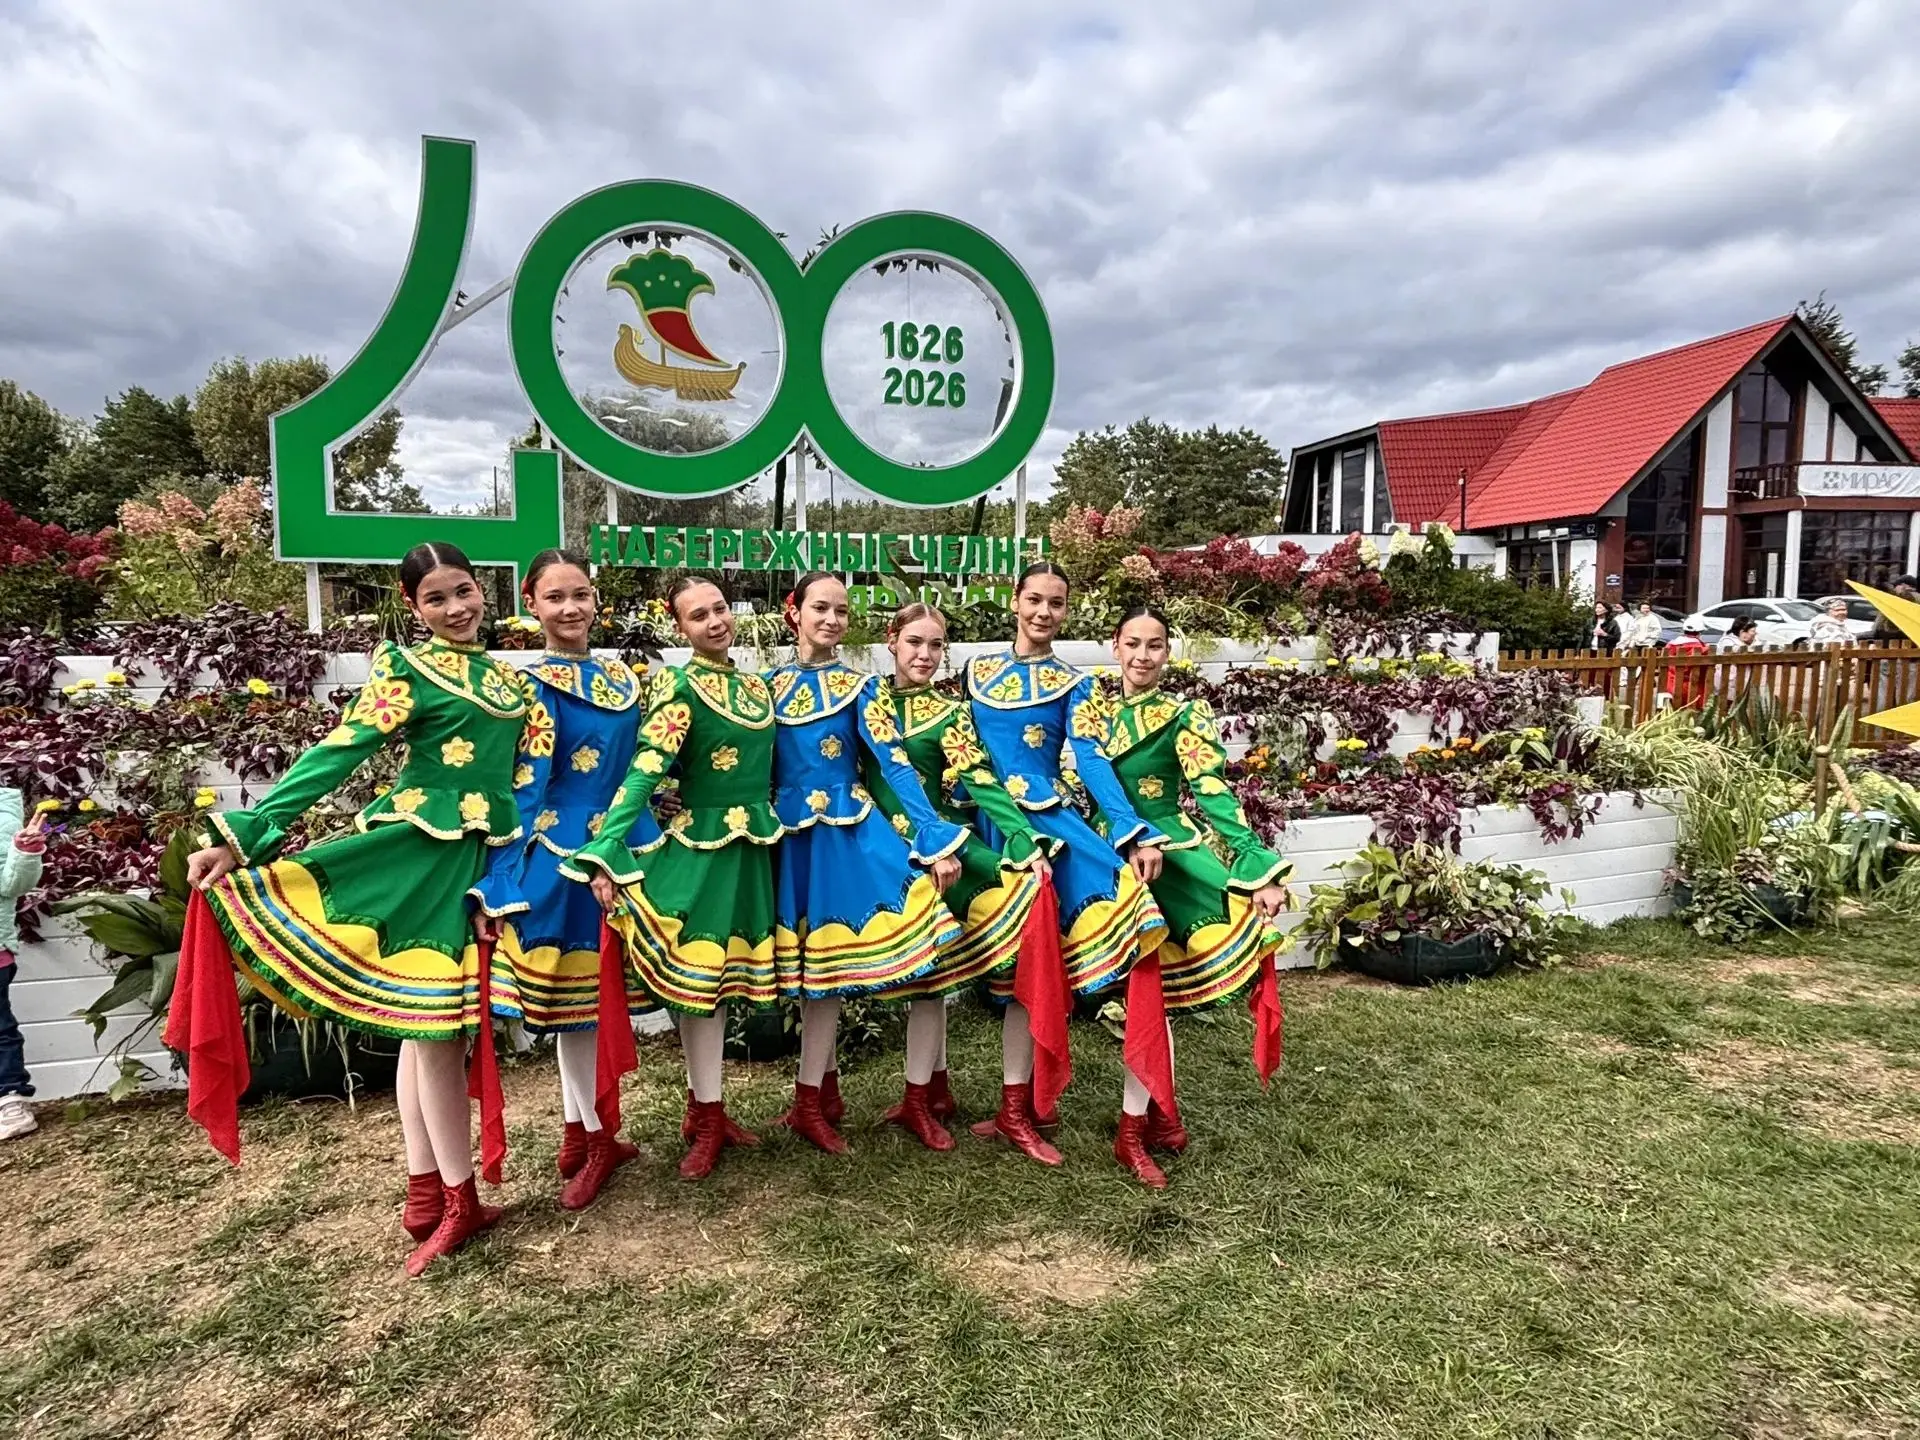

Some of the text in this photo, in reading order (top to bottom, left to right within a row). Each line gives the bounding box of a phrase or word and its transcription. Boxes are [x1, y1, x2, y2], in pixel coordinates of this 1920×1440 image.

[881, 321, 964, 364] 1626
[270, 135, 1055, 619] 400
[882, 367, 966, 408] 2026
[590, 523, 898, 573] НАБЕРЕЖНЫЕ
